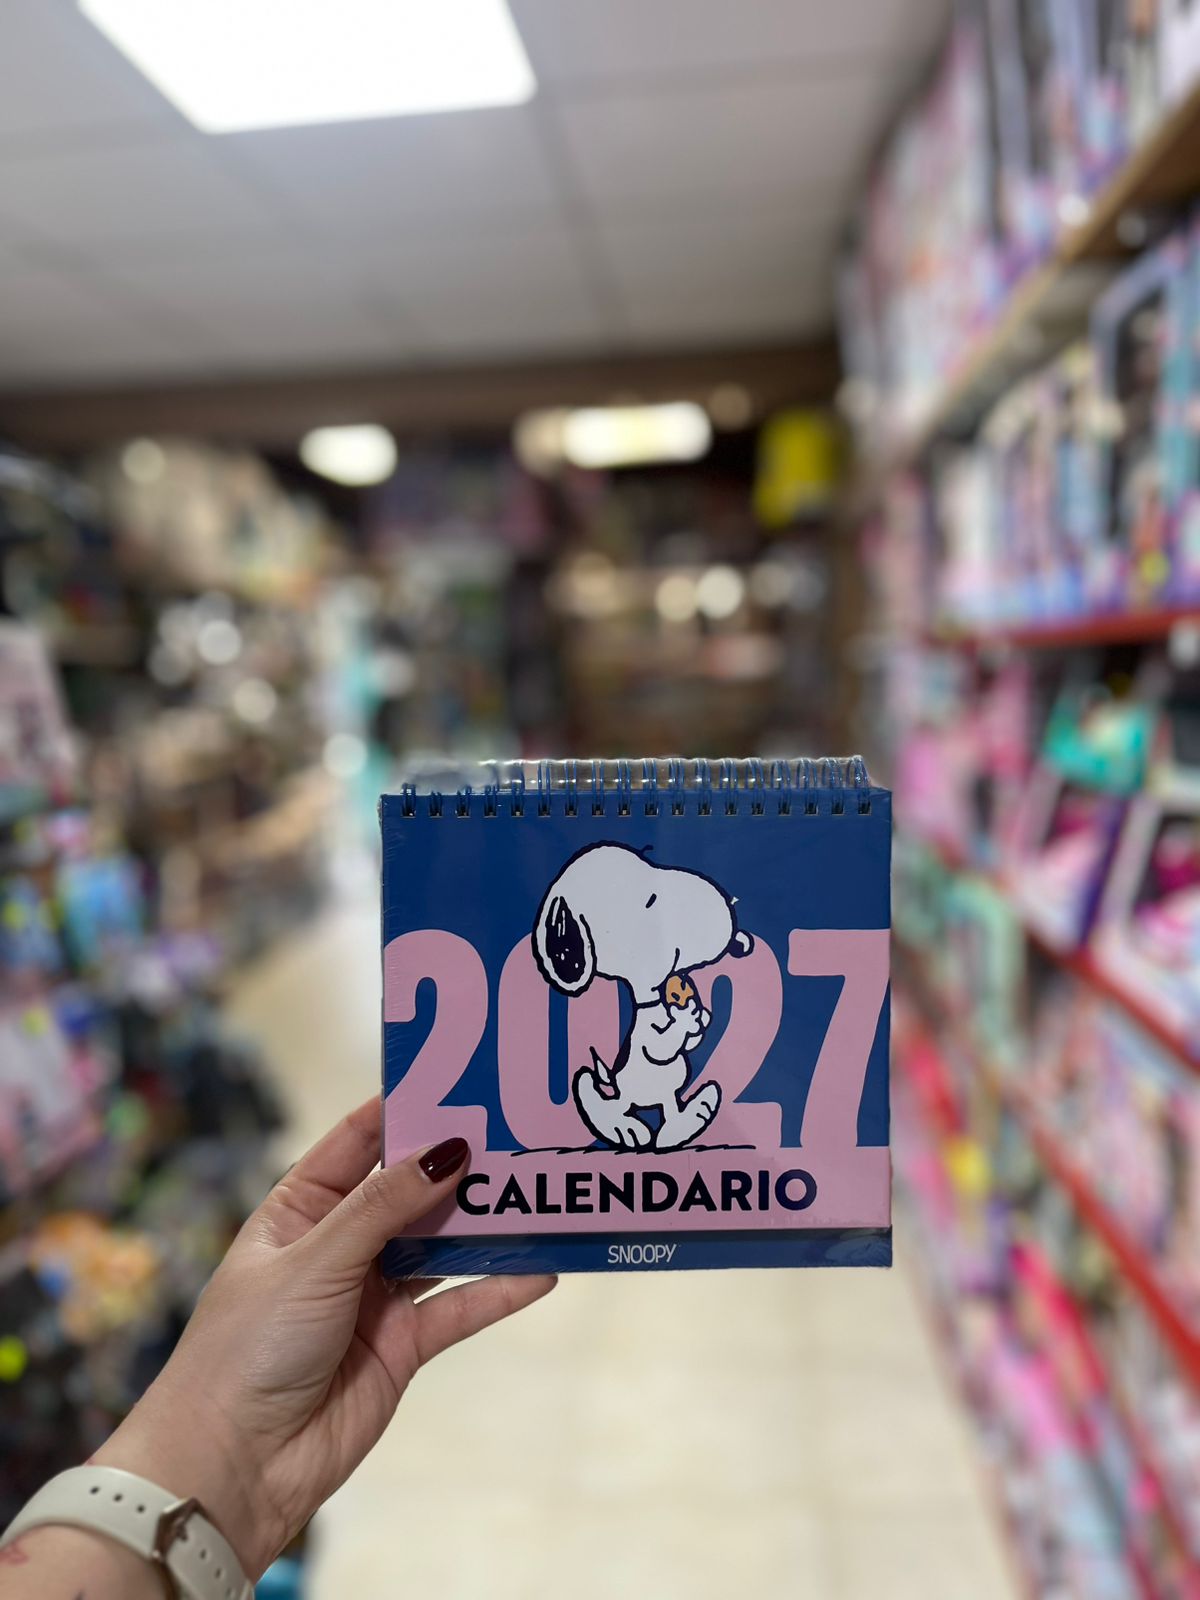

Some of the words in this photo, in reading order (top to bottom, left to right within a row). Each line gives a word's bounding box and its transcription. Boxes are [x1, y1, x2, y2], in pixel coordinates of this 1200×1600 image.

[383, 928, 891, 1148] 2027
[456, 1169, 818, 1216] CALENDARIO
[607, 1243, 677, 1264] SNOOPY
